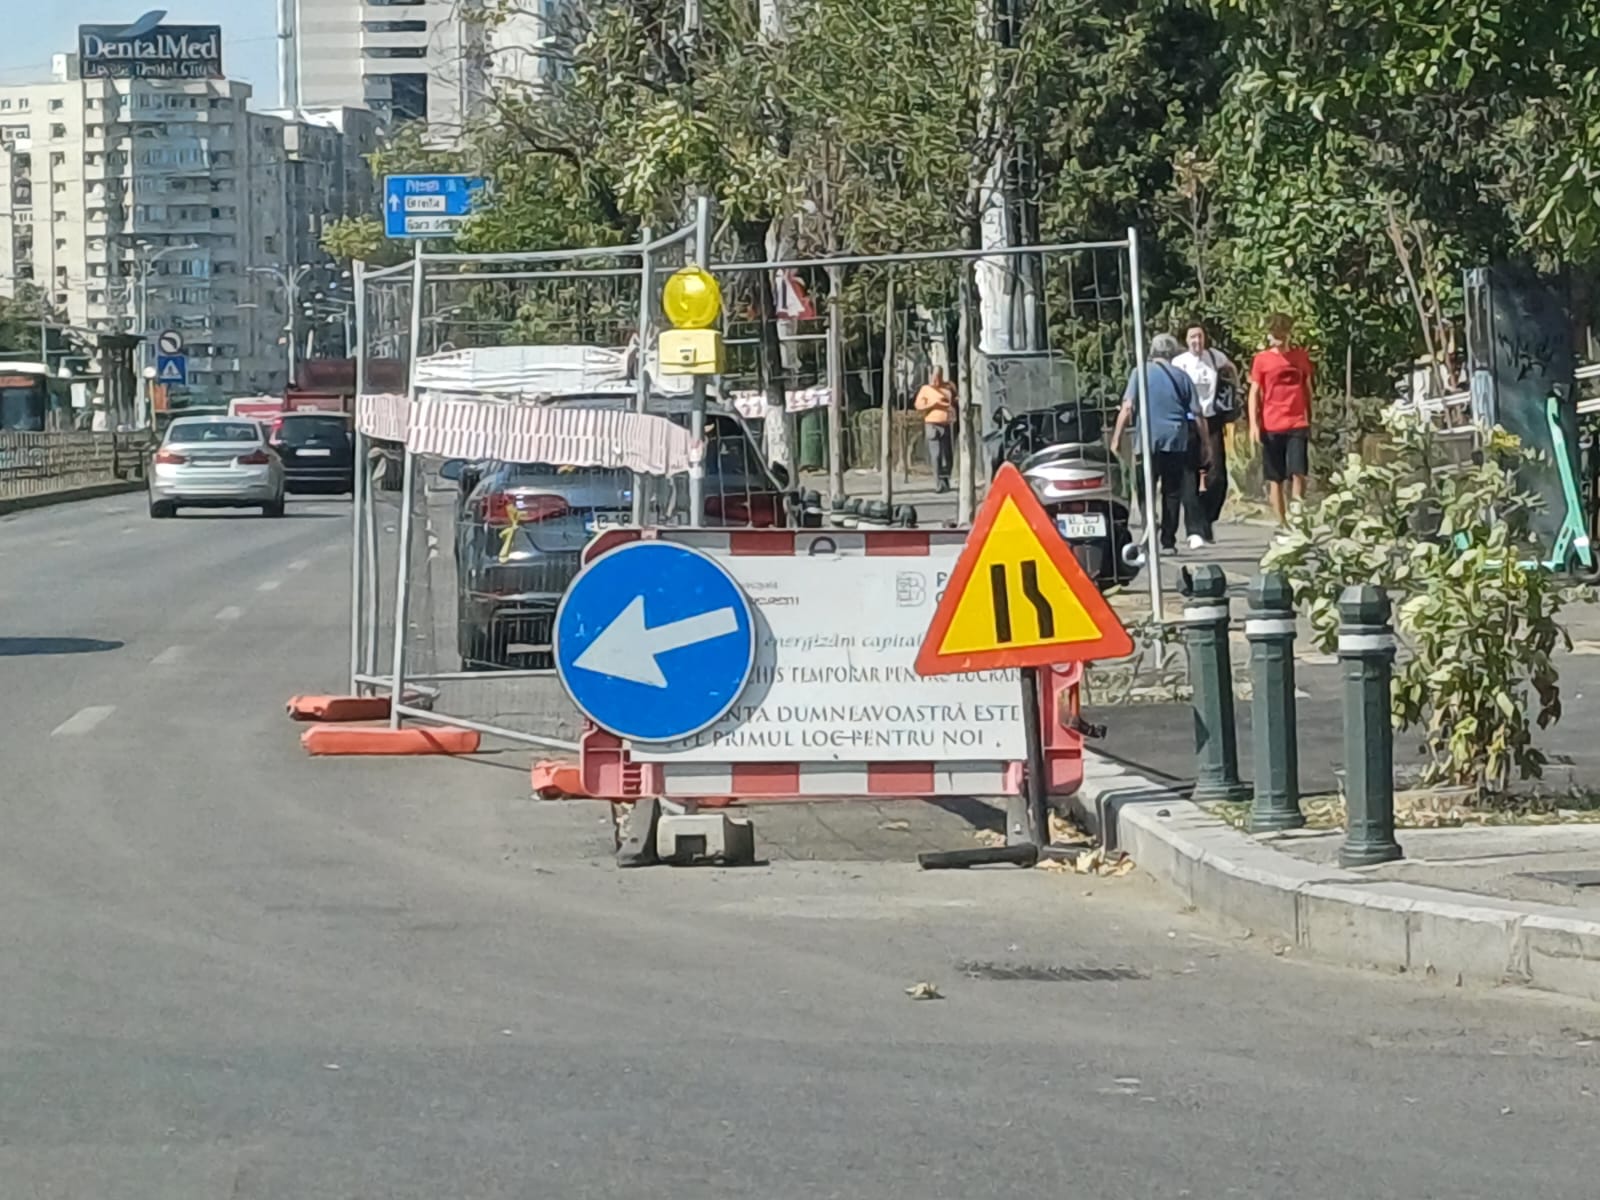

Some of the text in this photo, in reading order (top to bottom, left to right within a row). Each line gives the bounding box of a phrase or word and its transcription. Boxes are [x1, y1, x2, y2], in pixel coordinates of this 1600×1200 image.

[82, 33, 218, 60] DentalMed
[861, 631, 922, 652] capital
[792, 665, 881, 683] TEMPORAR
[974, 704, 1019, 722] ESTE
[713, 730, 795, 748] PRIMUL
[802, 729, 844, 748] LOC
[851, 729, 935, 747] PENTRU
[943, 729, 983, 747] NOI
